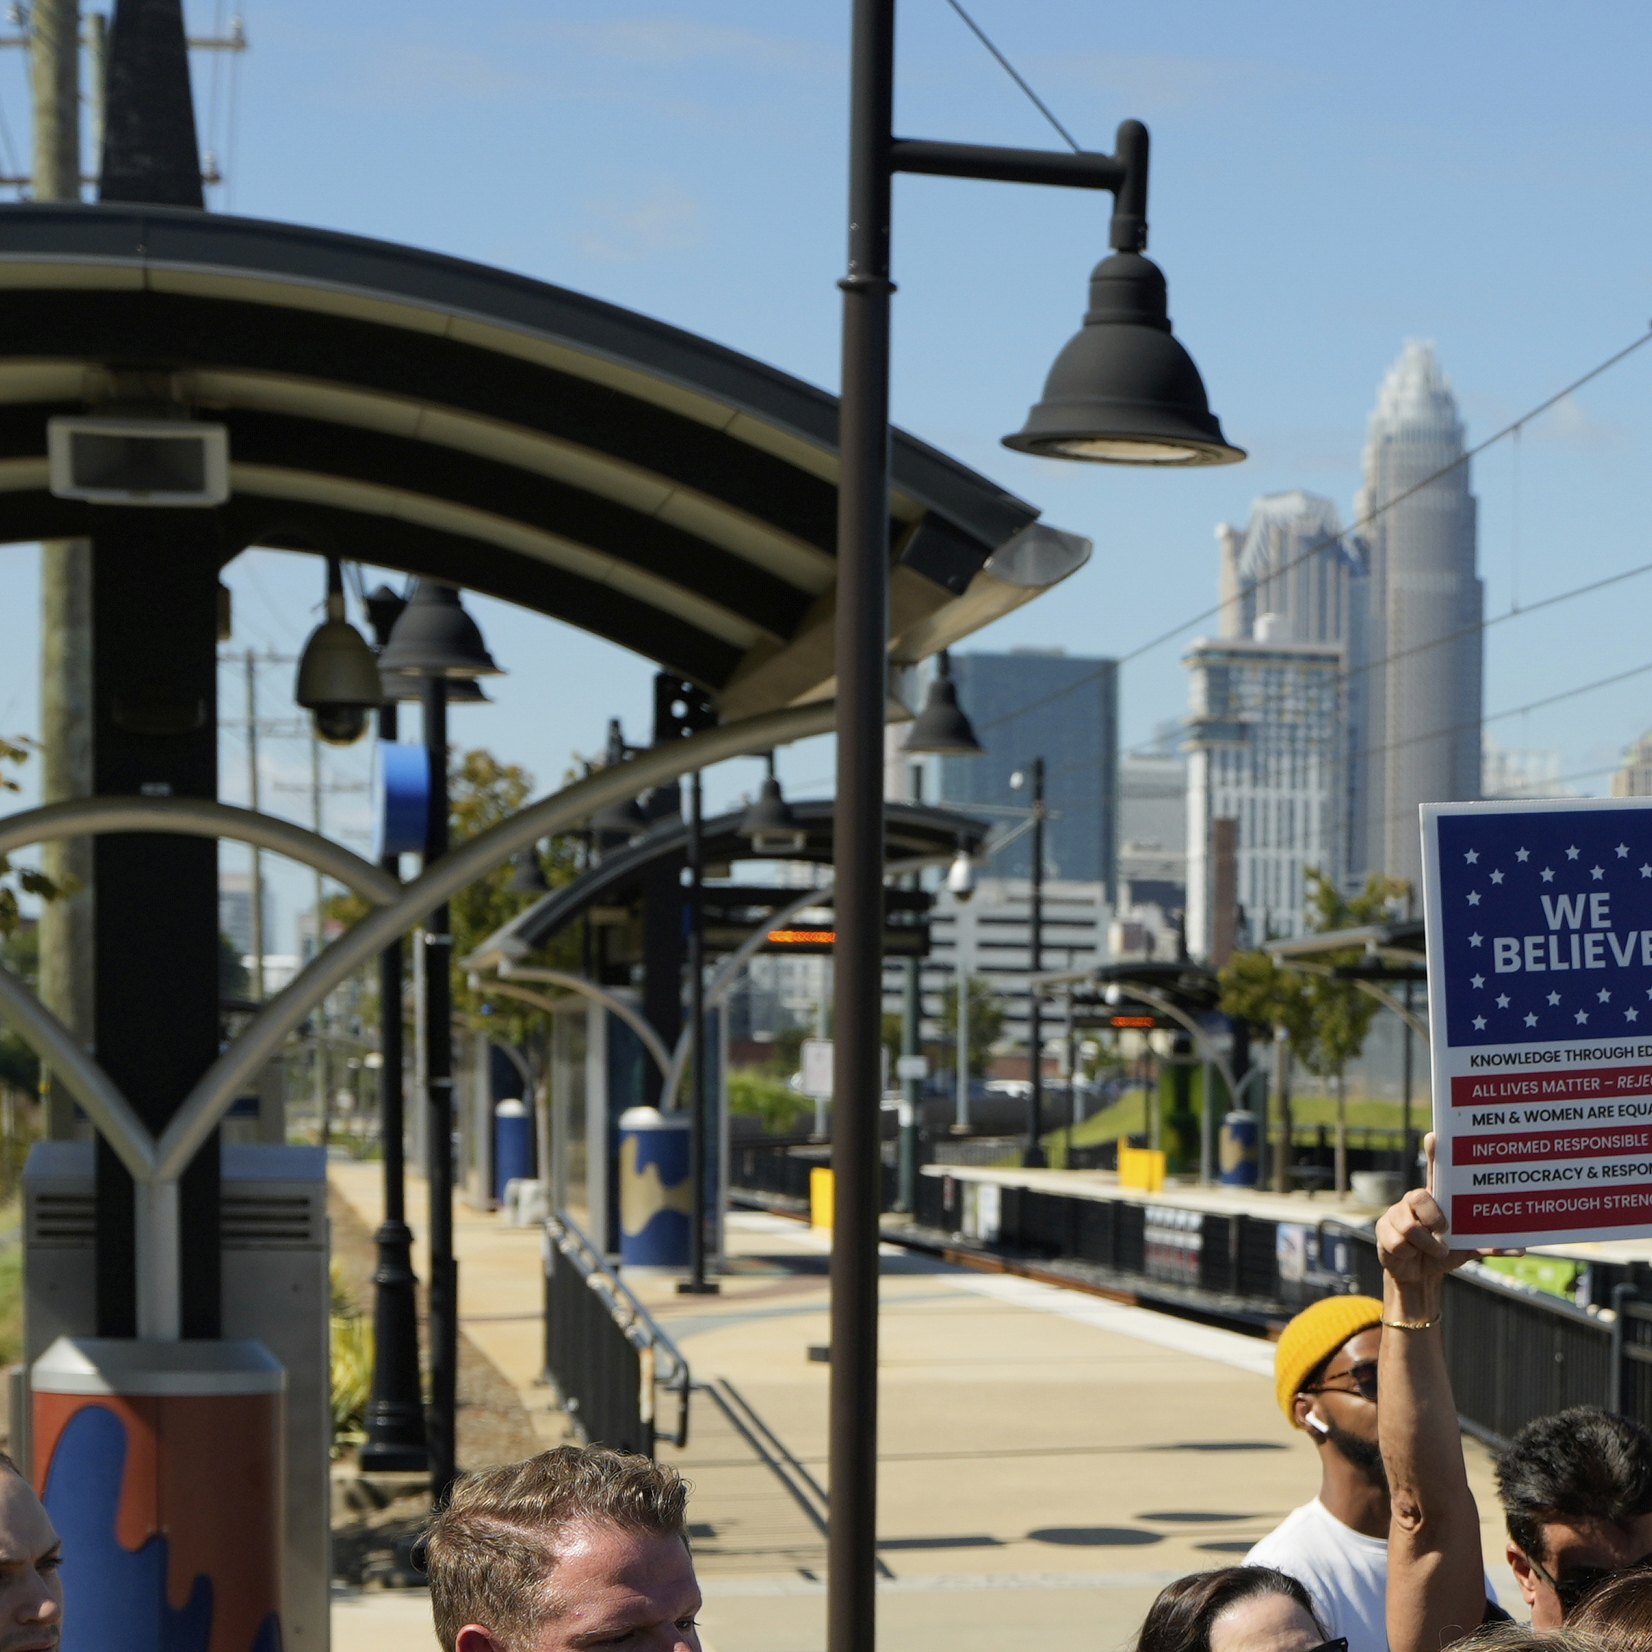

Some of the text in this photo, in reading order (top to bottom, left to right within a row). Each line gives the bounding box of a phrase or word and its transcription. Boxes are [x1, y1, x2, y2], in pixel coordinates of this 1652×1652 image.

[1540, 892, 1612, 931] WE
[1470, 1050, 1562, 1068] KNOWLEDGE
[1563, 1045, 1635, 1062] THROUGH
[1472, 1083, 1498, 1098] ALL
[1500, 1080, 1539, 1096] LIVES
[1542, 1077, 1601, 1094] MATTER
[1471, 1111, 1505, 1127] MEN
[1508, 1111, 1521, 1125] &
[1523, 1106, 1584, 1123] WOMEN
[1587, 1105, 1615, 1119] ARE
[1472, 1139, 1551, 1157] INFORMED
[1554, 1133, 1649, 1152] RESPONSIBLE
[1472, 1166, 1584, 1187] MERITOCRACY
[1586, 1166, 1599, 1179] &
[1472, 1201, 1522, 1217] PEACE
[1525, 1196, 1600, 1214] THROUGH
